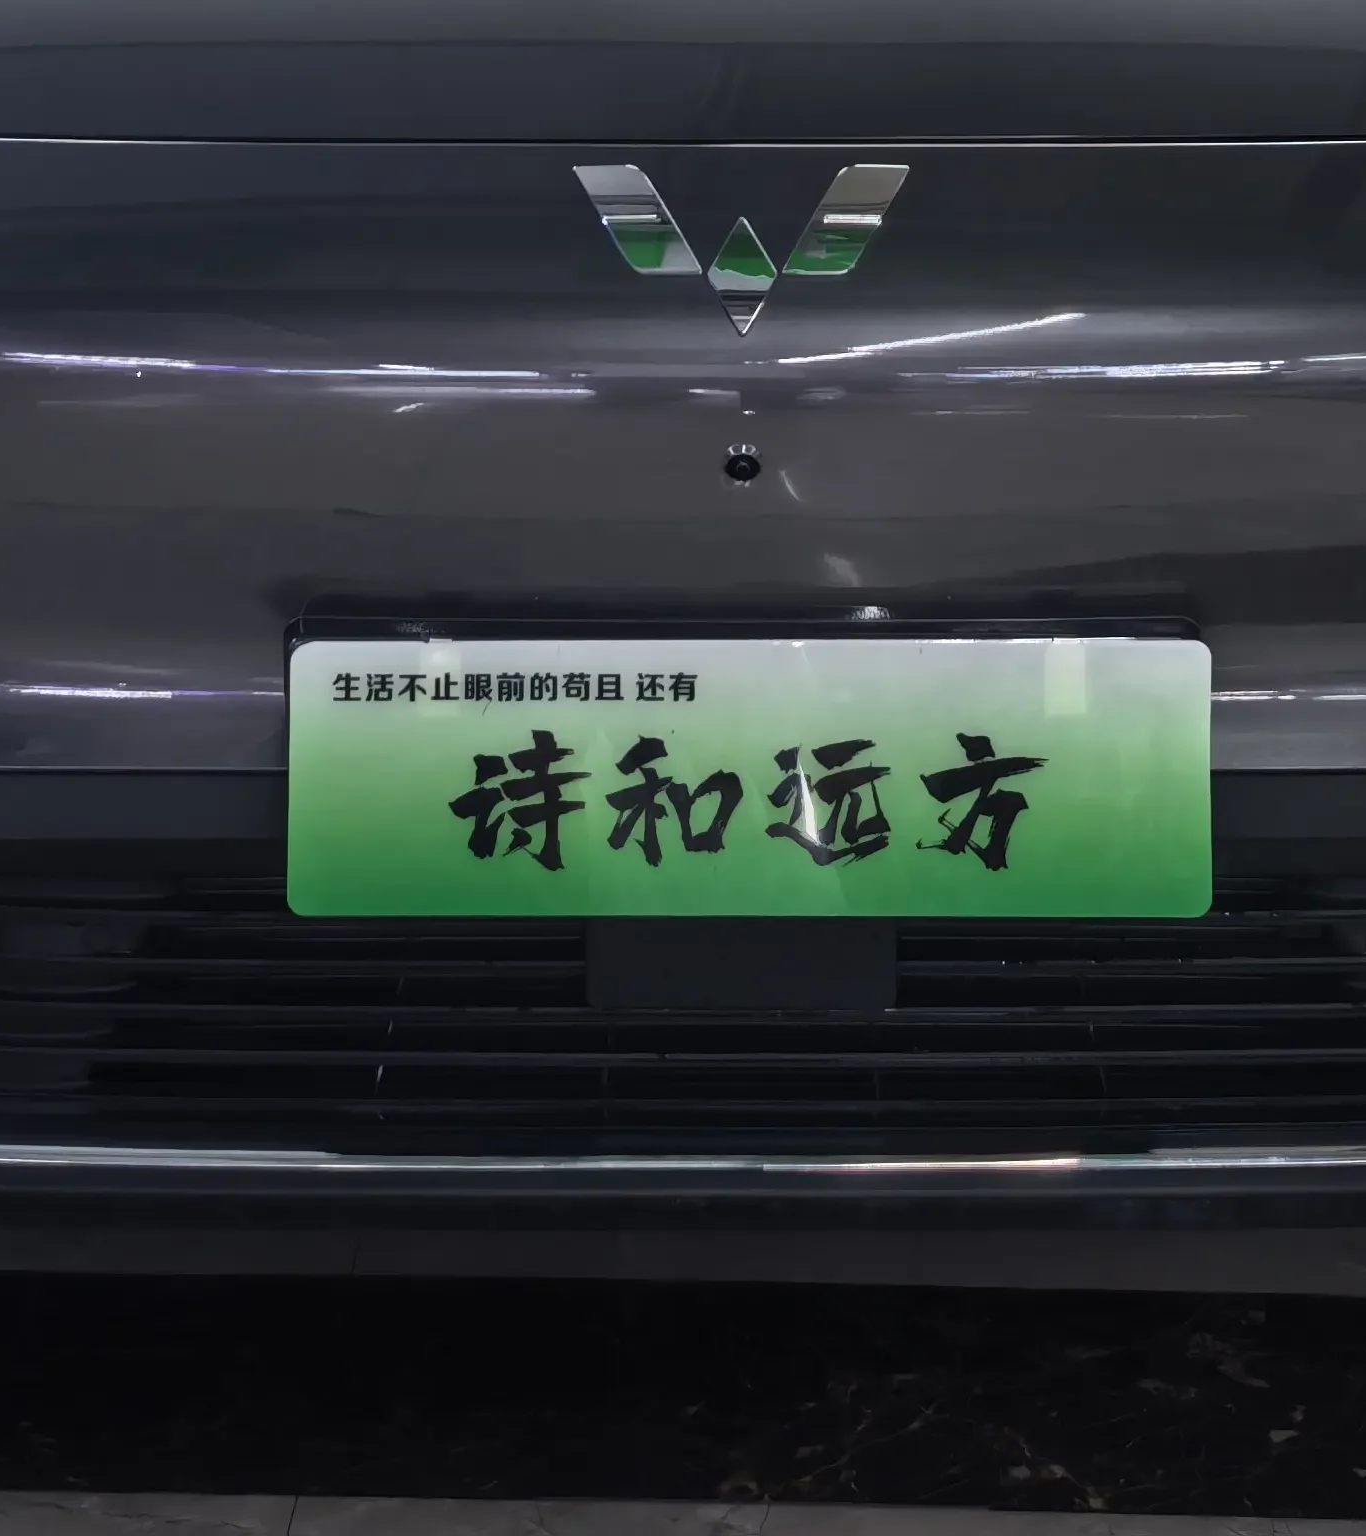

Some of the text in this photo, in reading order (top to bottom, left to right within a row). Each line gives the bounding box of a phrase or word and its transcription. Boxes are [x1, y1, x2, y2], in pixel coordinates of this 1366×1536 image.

[331, 672, 699, 703] 生活不止眼前的苟且 还有
[447, 728, 1050, 872] 诗和远方
